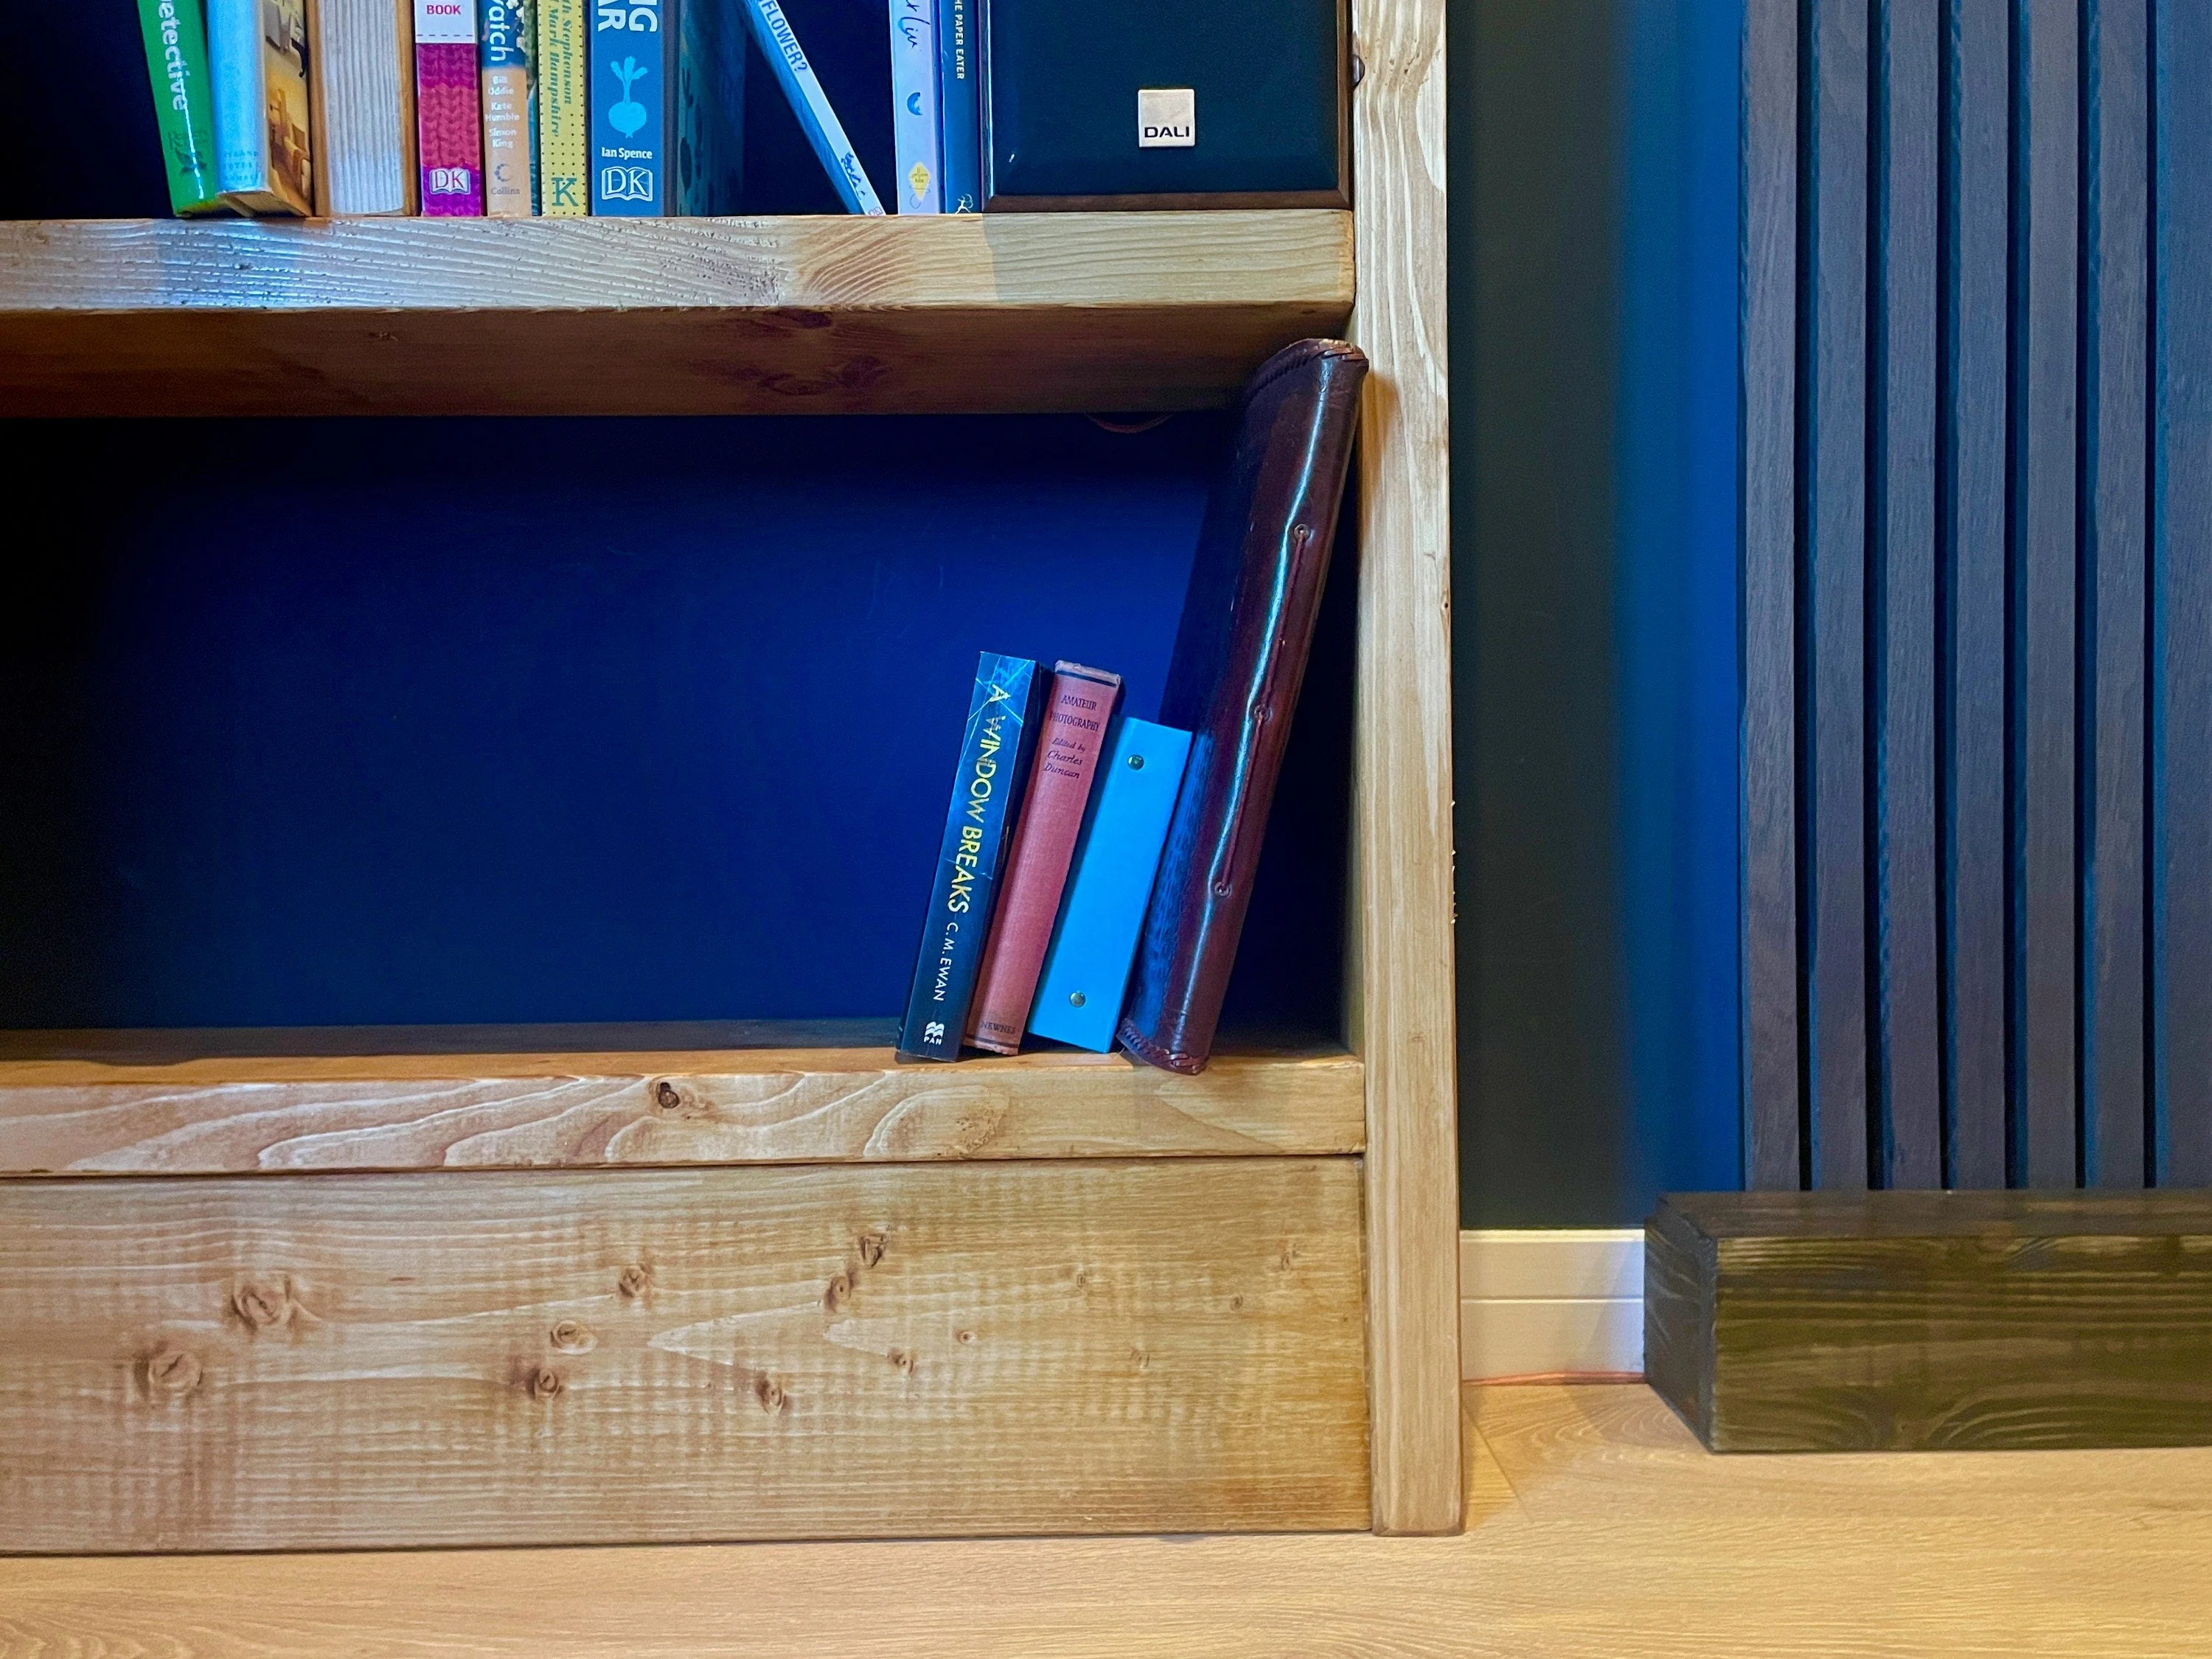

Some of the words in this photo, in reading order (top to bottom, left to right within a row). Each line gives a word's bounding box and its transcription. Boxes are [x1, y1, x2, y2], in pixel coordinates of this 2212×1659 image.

[426, 4, 462, 15] BOOK
[598, 0, 626, 32] R
[629, 0, 658, 32] G
[488, 0, 515, 61] atch
[549, 7, 559, 47] Mark
[955, 14, 964, 46] PAPER
[159, 0, 190, 111] etective
[557, 18, 573, 105] Stephenson
[956, 49, 965, 79] EATER
[547, 52, 561, 138] Hampshire
[484, 112, 520, 122] Humble
[1144, 126, 1190, 138] DALI
[601, 147, 616, 159] Ian
[618, 147, 653, 161] Spence
[434, 171, 465, 189] DK
[490, 187, 521, 196] Collins
[551, 177, 580, 207] K
[606, 167, 647, 196] DK
[988, 684, 1012, 703] A
[1060, 695, 1097, 712] AMATEUR
[1050, 712, 1100, 732] PHOTOGRAPHY
[1051, 737, 1077, 749] Edited
[1077, 743, 1086, 753] by
[966, 715, 1006, 824] WINDOW
[1047, 750, 1083, 766] Charles
[1044, 762, 1080, 779] Duncan
[947, 825, 983, 914] BREAKS
[923, 1035, 943, 1046] PAN
